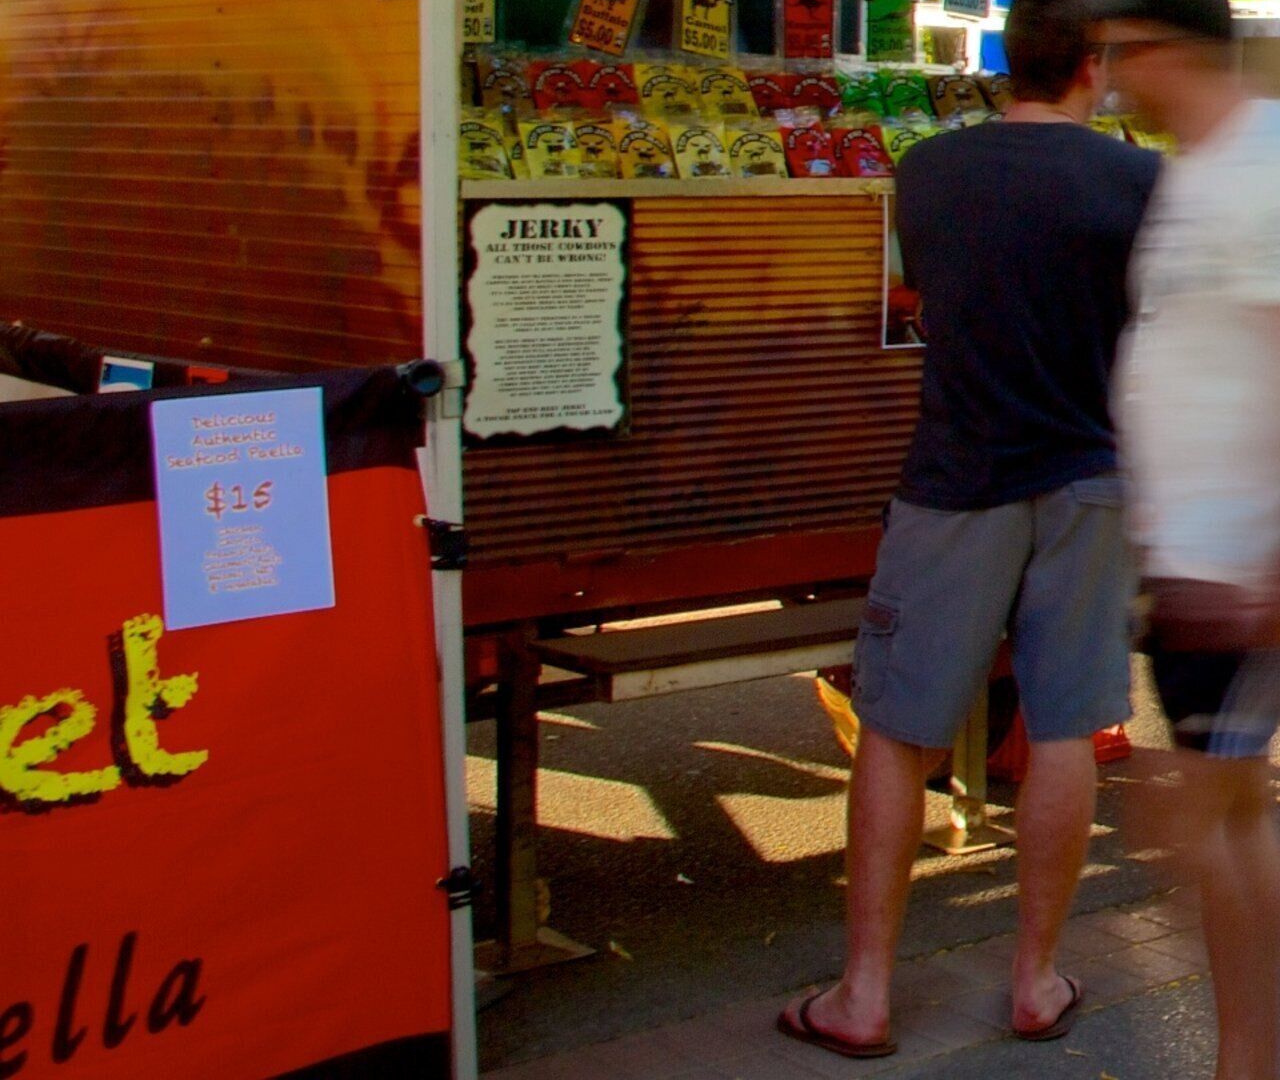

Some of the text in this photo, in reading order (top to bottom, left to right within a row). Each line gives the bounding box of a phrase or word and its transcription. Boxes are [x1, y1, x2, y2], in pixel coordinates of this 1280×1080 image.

[501, 218, 604, 240] JERKY
[486, 241, 617, 253] ALL THOSE COWBOYS
[494, 253, 607, 265] CAN'T BE WRONG!
[193, 411, 276, 429] Delicious
[192, 430, 278, 447] Authentic
[167, 444, 304, 469] Seafood Paella
[205, 480, 274, 520] $15
[0, 612, 208, 802] et
[0, 930, 207, 1079] ella
